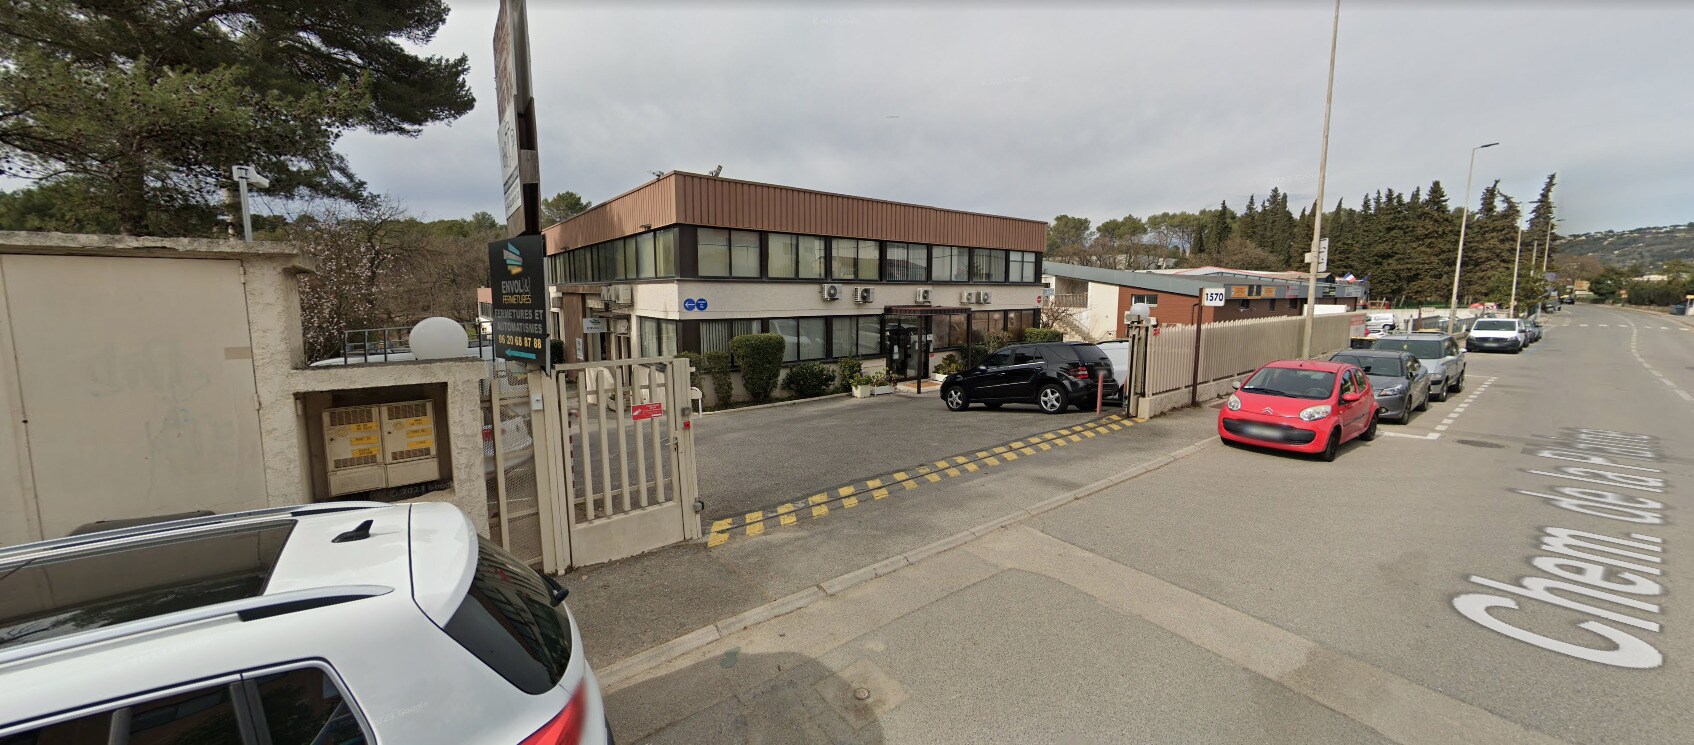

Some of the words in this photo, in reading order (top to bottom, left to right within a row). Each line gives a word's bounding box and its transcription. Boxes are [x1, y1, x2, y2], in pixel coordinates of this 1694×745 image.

[1205, 292, 1224, 302] 1570
[494, 309, 533, 320] FERMETURES
[534, 309, 544, 320] ET
[497, 321, 543, 334] AUTOMATISMES
[498, 334, 506, 344] 06
[506, 335, 514, 345] 20
[533, 337, 542, 349] 88
